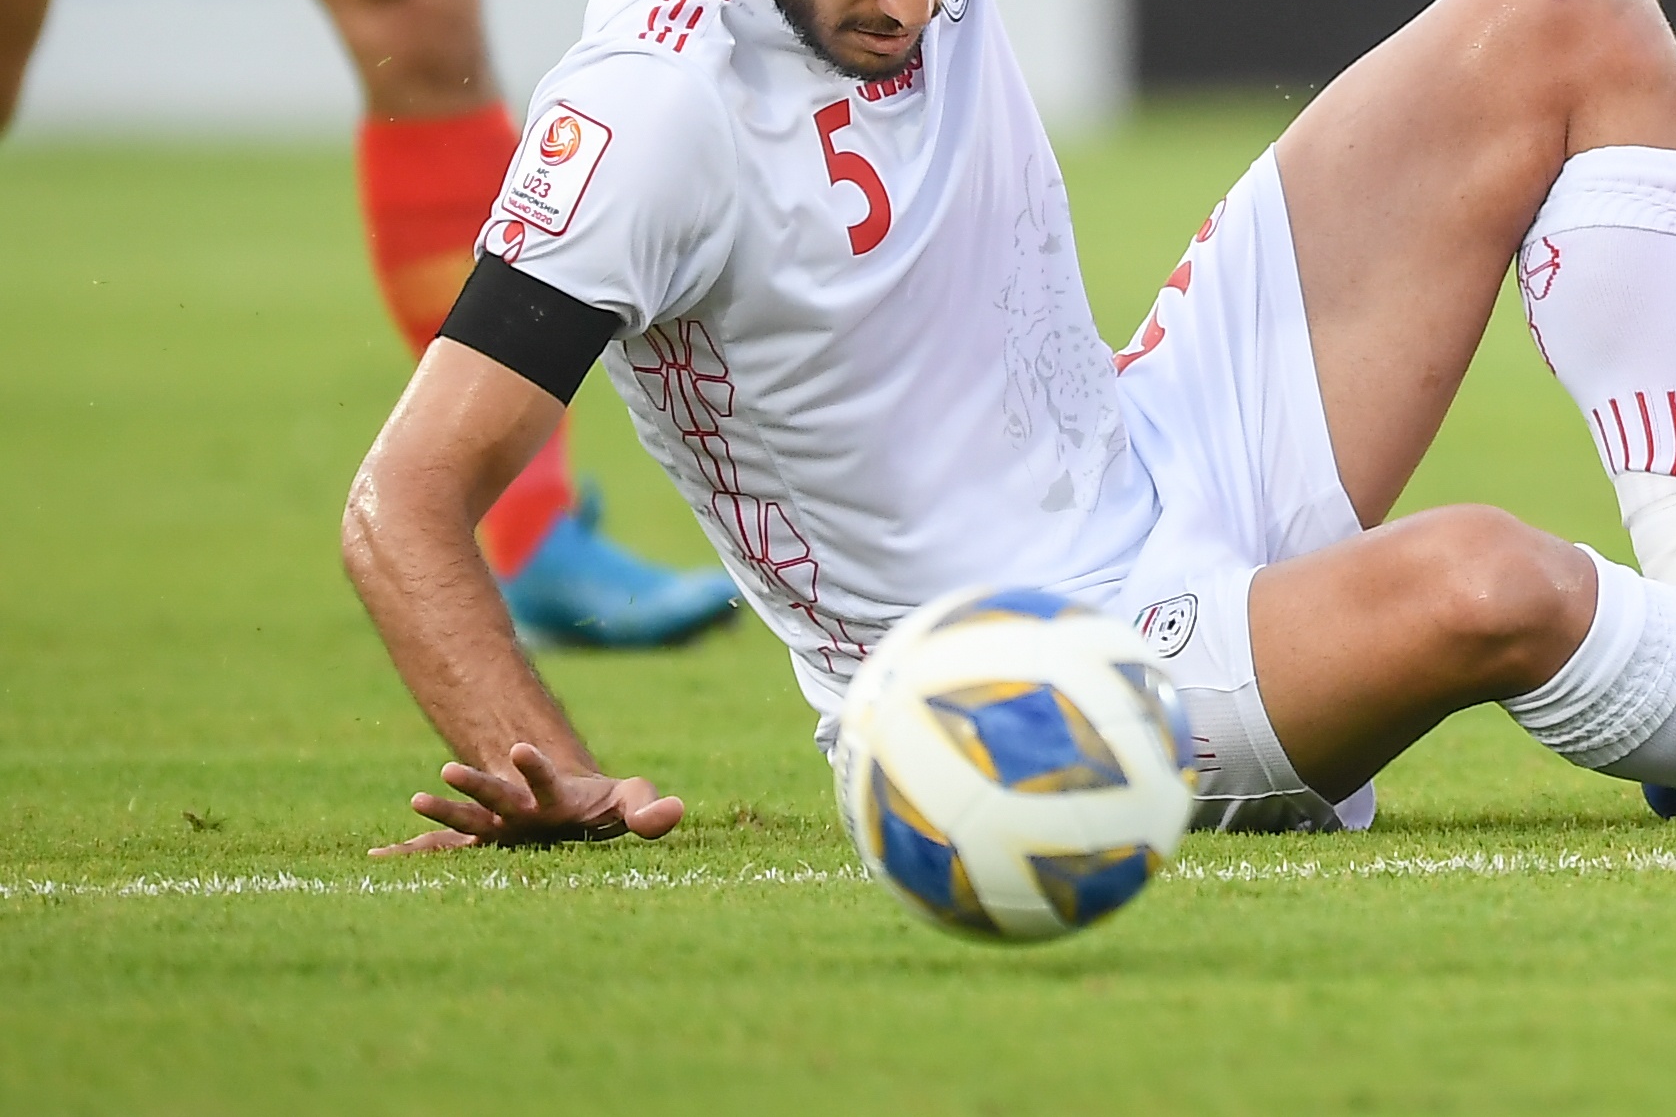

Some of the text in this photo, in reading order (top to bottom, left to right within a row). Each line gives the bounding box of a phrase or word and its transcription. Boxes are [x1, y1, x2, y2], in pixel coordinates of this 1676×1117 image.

[522, 172, 552, 199] U23
[813, 97, 892, 257] 5
[531, 209, 553, 226] 2020
